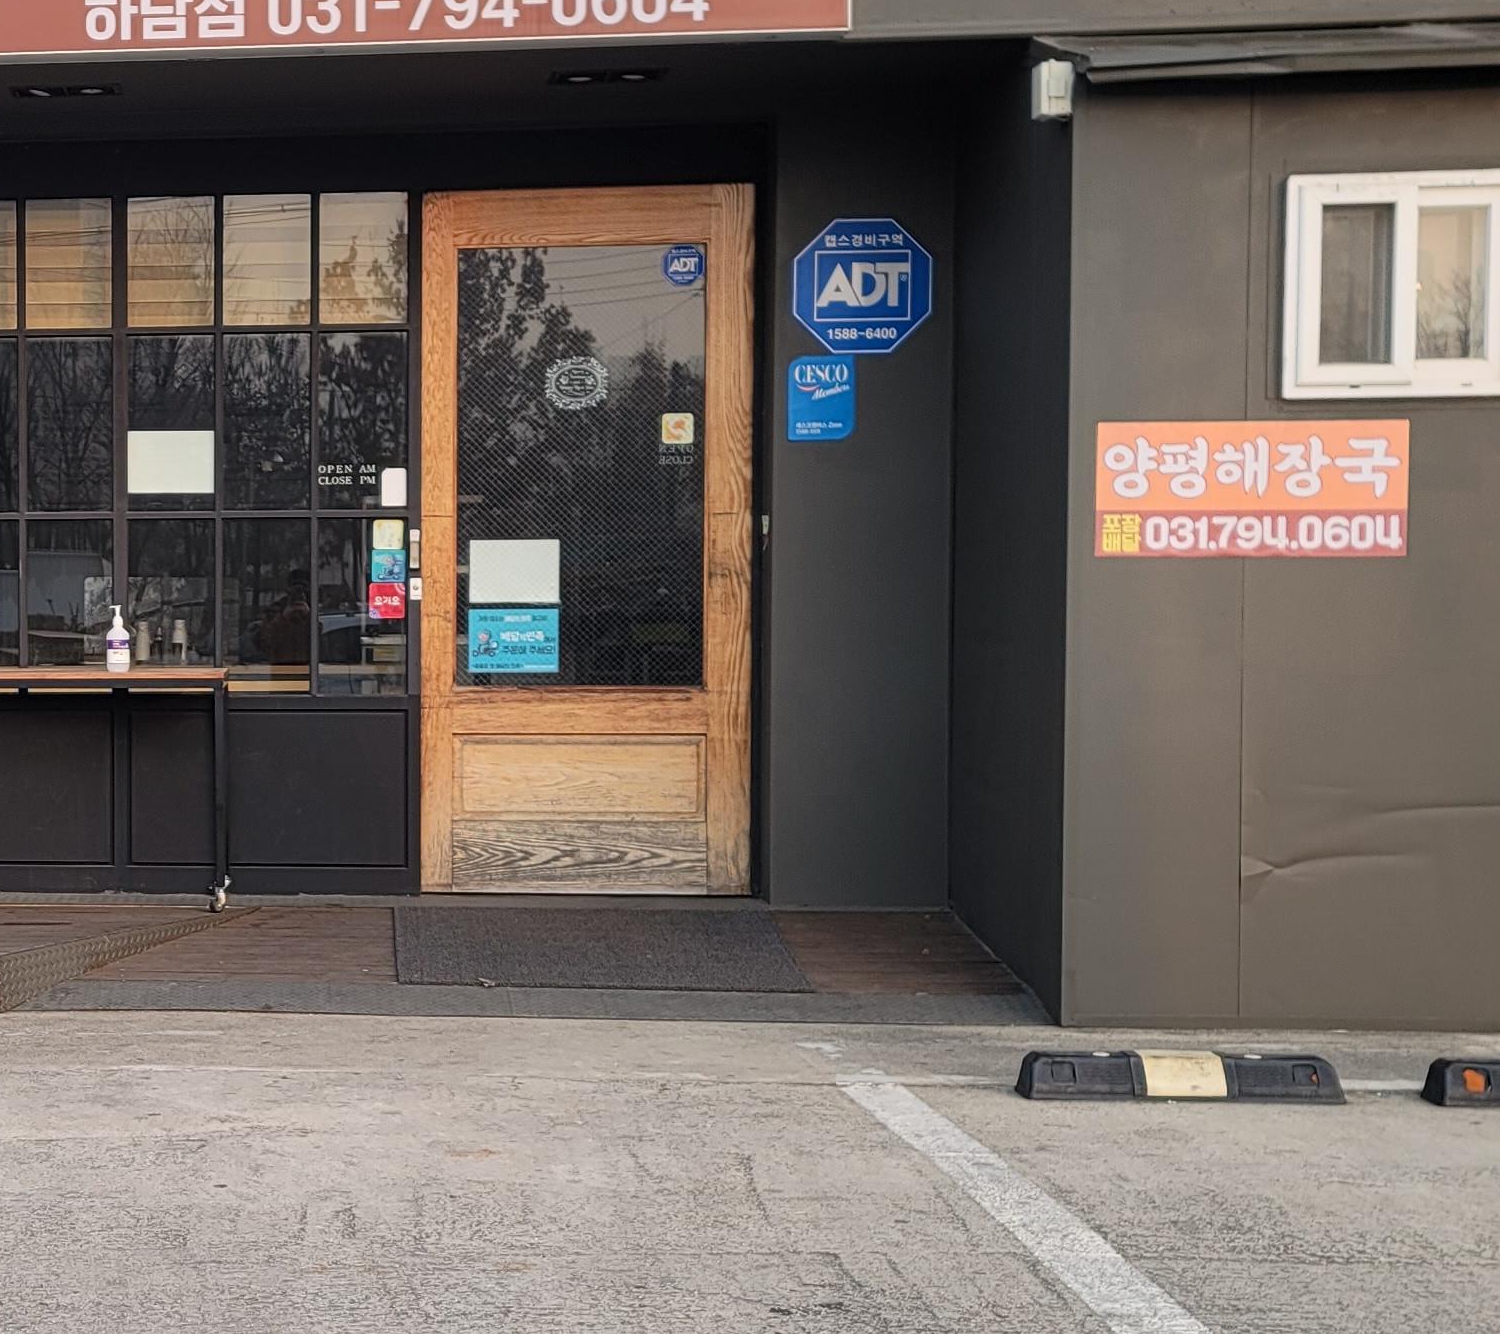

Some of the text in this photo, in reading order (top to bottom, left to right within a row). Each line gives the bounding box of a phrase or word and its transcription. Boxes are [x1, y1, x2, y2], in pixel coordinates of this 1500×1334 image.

[824, 234, 903, 247] 캡스경비구역
[669, 258, 698, 272] ADT
[816, 262, 909, 307] ADT
[826, 327, 897, 340] 1588-6400
[794, 364, 849, 384] CESCO
[318, 464, 376, 474] OPEN AM
[1104, 435, 1400, 498] 양평해장국
[318, 476, 376, 485] CLOSE PM
[1145, 515, 1403, 550] 031.794.0604
[374, 595, 400, 605] 요기요
